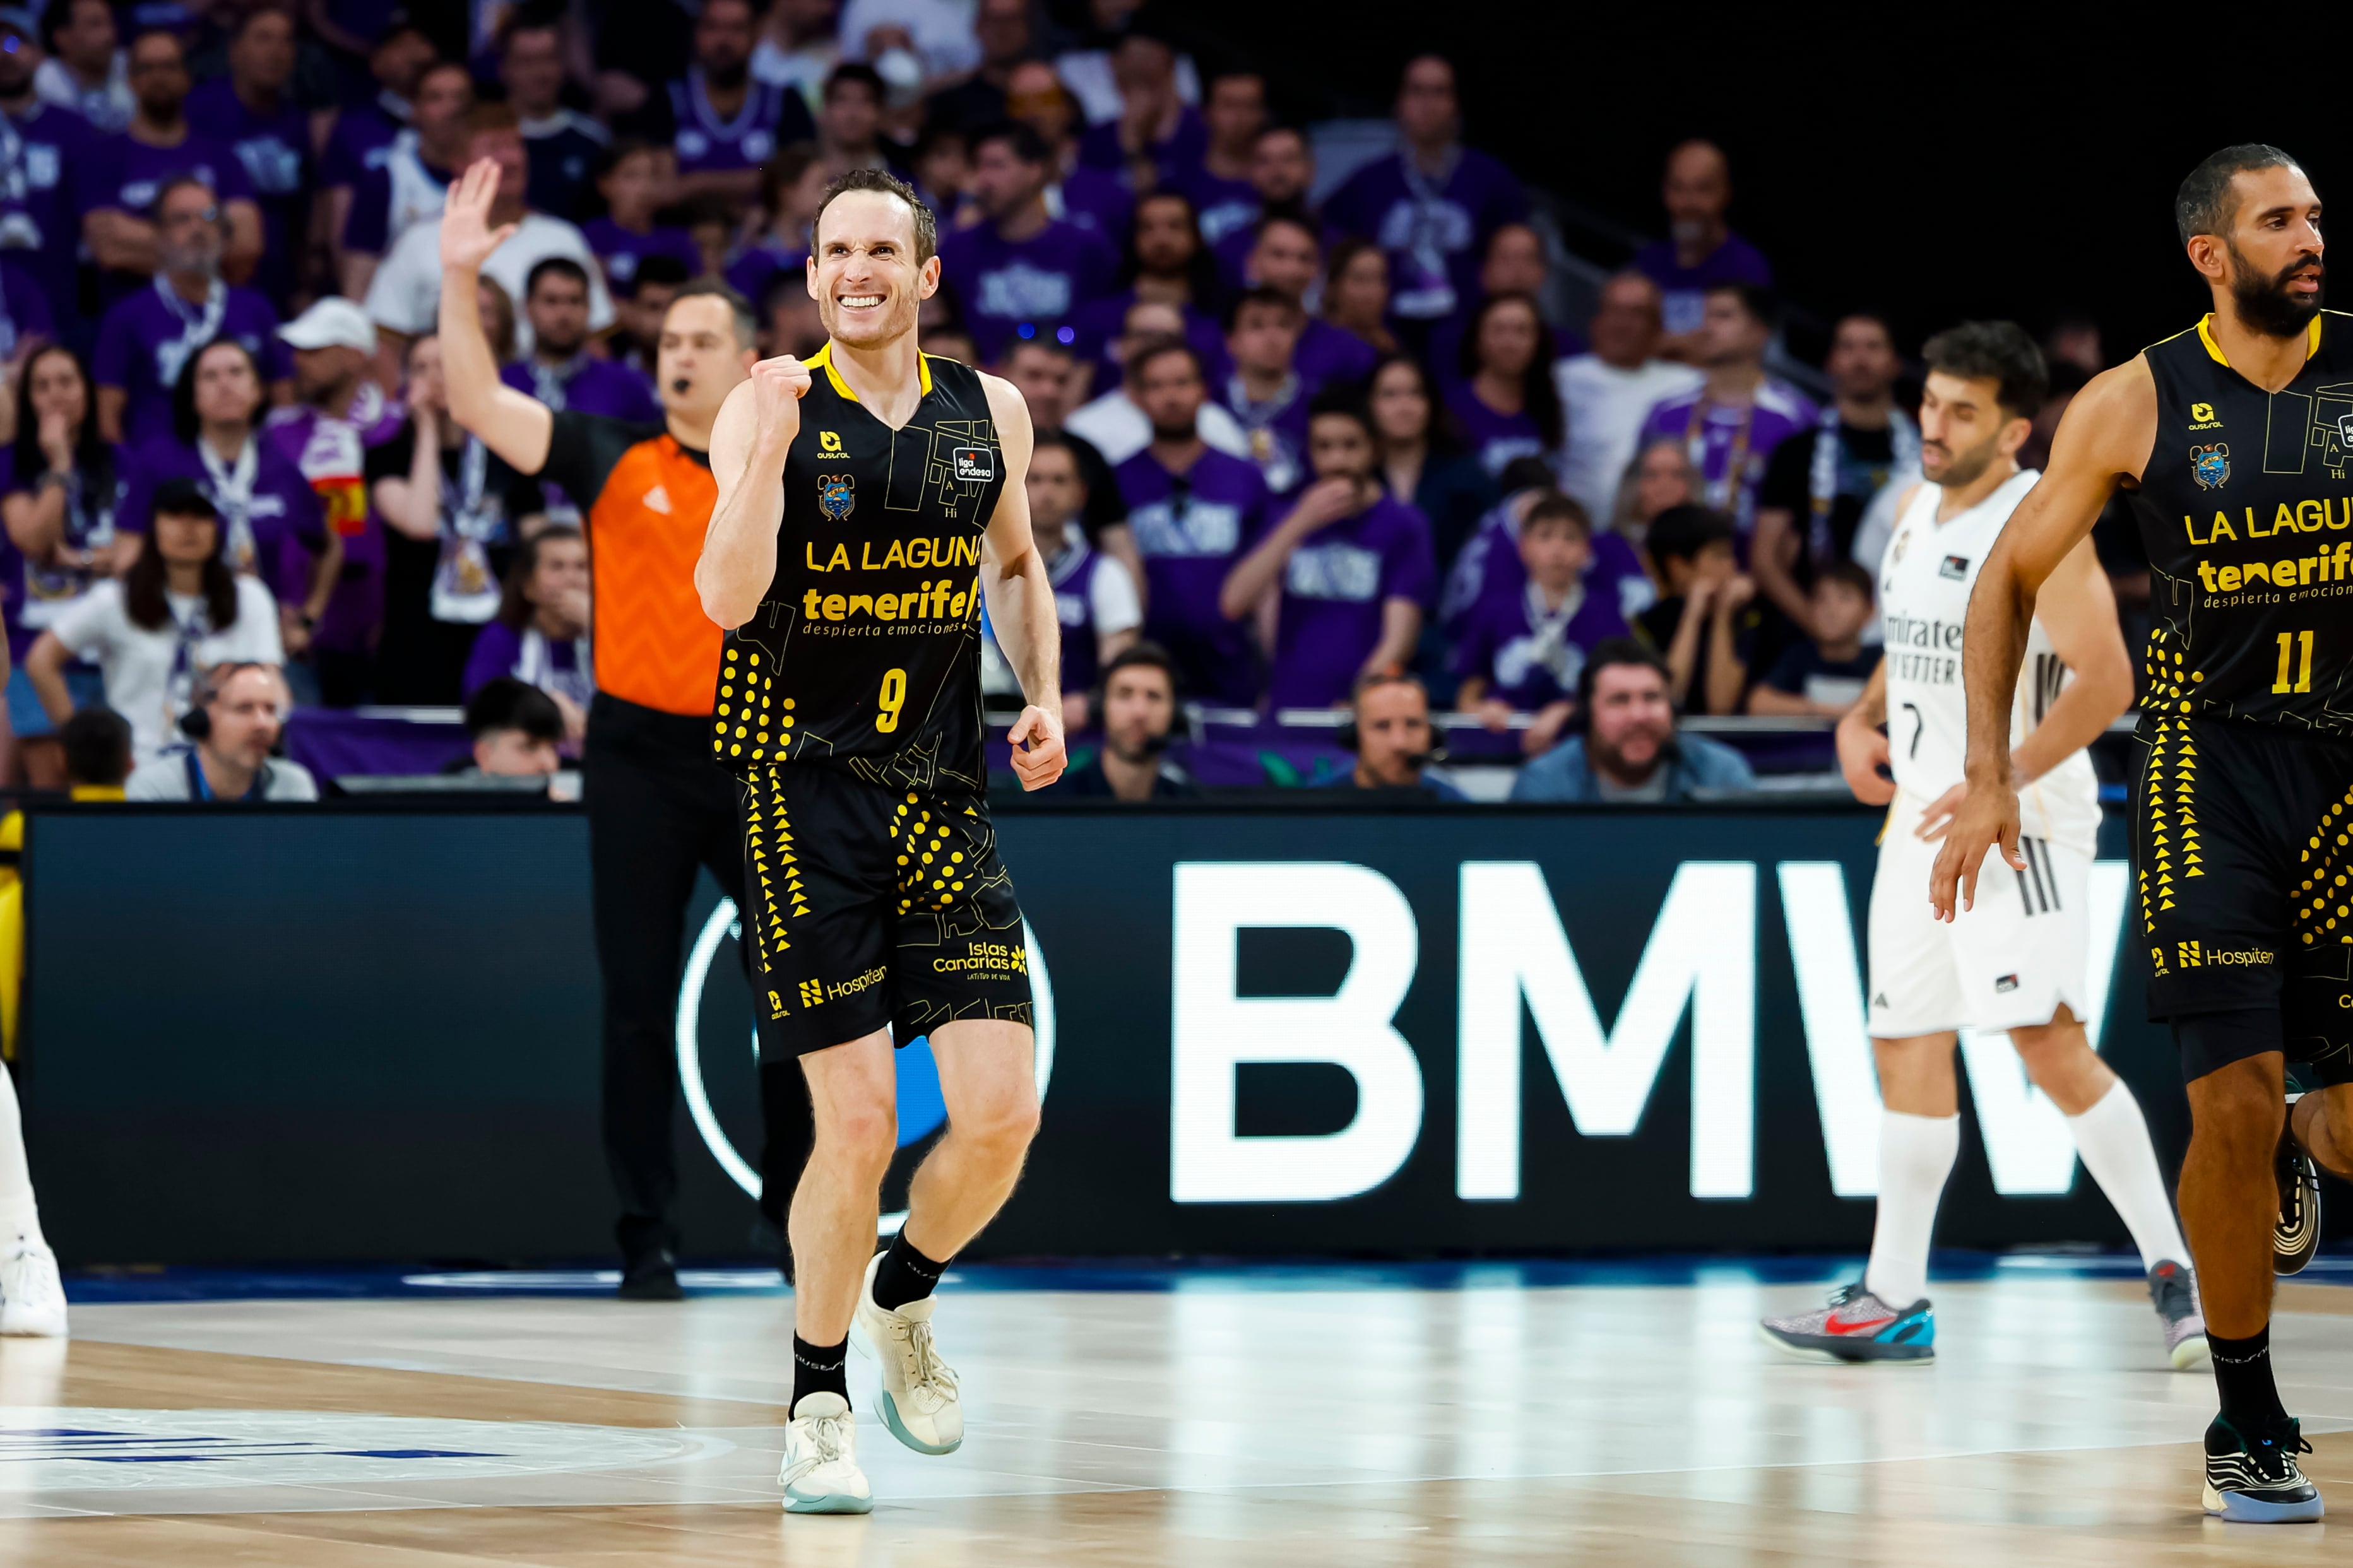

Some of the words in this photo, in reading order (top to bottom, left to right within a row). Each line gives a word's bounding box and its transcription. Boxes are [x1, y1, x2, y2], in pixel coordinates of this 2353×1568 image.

[2188, 421, 2224, 430] austral
[958, 457, 974, 468] liga
[959, 468, 991, 477] endesa
[2184, 510, 2238, 545] LA
[2245, 497, 2353, 538] LAGU
[807, 541, 851, 572] LA
[2198, 541, 2353, 593] tenerif
[2203, 592, 2280, 608] despierta
[803, 622, 881, 638] despierta
[887, 622, 959, 637] emociones
[2272, 631, 2313, 693] 11
[876, 668, 906, 733] 9
[1902, 702, 1923, 760] 7
[969, 941, 1008, 957] Islas
[2207, 948, 2273, 967] Hospiten
[933, 955, 1009, 972] Canarias
[827, 965, 887, 1000] Hospiten
[1170, 860, 2130, 1202] BMW
